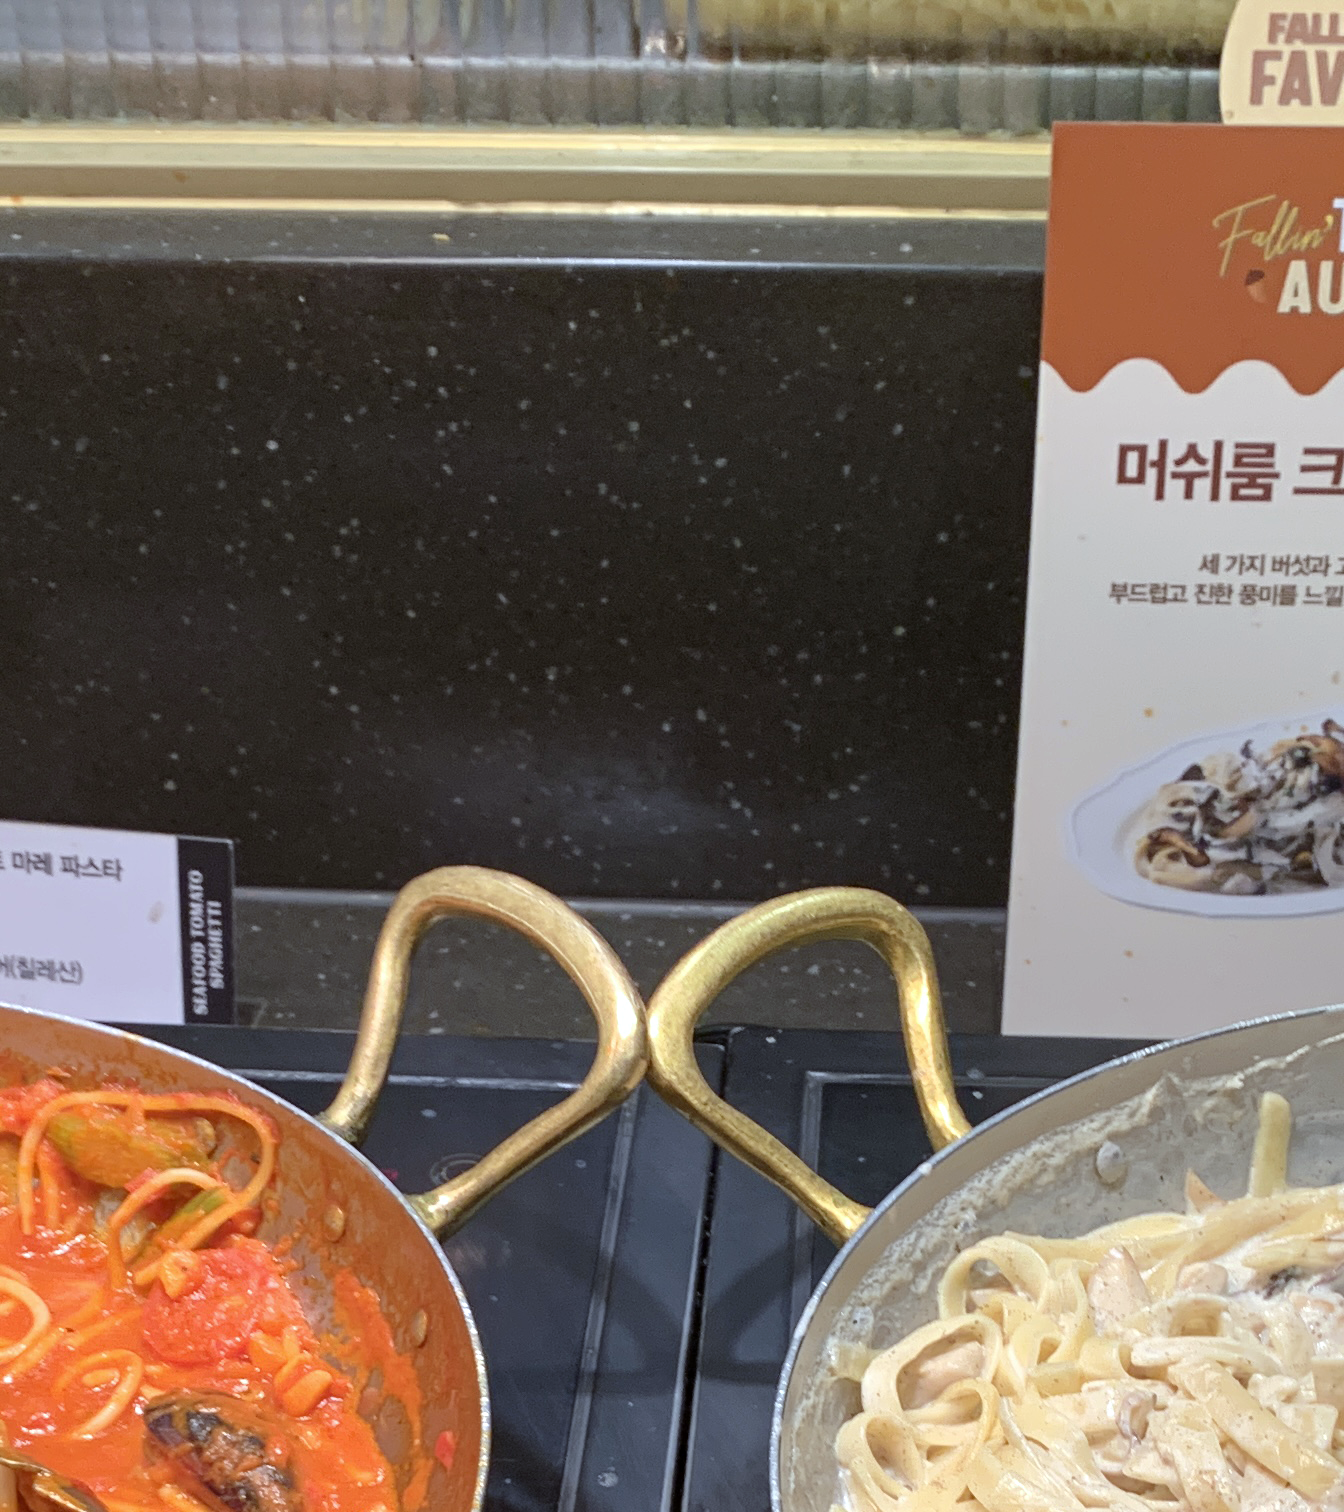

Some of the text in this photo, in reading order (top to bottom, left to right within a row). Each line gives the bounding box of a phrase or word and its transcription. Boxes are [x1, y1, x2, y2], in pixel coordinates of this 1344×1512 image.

[1116, 438, 1281, 502] 머쉬룸
[1198, 553, 1220, 576] 세
[1224, 554, 1266, 577] 가지
[1271, 554, 1331, 578] 버섯과
[1109, 582, 1188, 605] 부드럽고
[1194, 582, 1233, 606] 진한
[1238, 583, 1298, 607] 풍미를
[1303, 585, 1344, 607] 느낄
[11, 850, 54, 876] 마레
[59, 854, 123, 882] 파스타
[187, 869, 210, 1016] SEAFOOD TOMATO
[206, 900, 226, 990] SPAGHETTI
